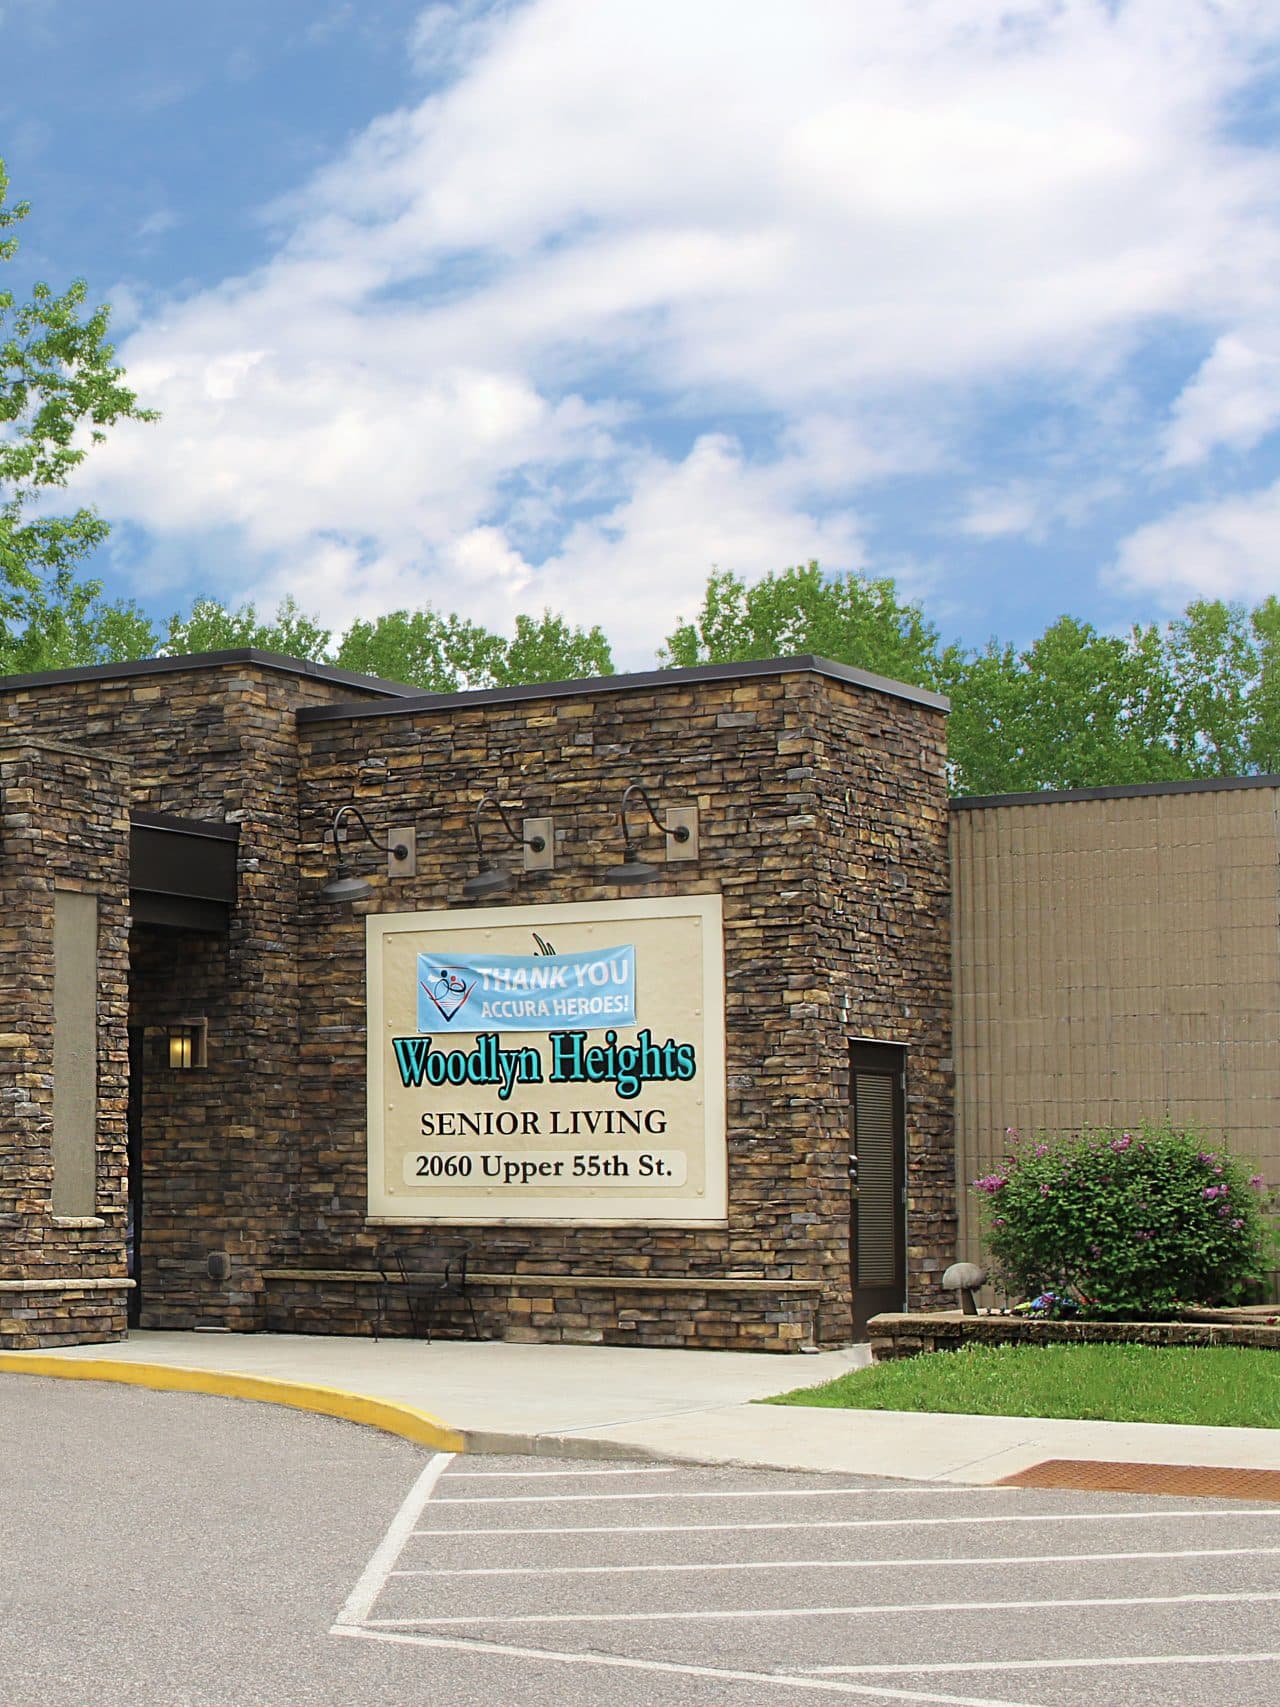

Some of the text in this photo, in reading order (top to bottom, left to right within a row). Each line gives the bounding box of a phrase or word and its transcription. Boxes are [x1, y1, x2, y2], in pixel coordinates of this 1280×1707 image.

[477, 959, 628, 992] THANK YOU
[481, 995, 629, 1018] ACCURA HEROES!
[392, 1029, 696, 1100] Woodlyn Heights
[420, 1109, 668, 1136] SENIOR LIVING
[415, 1154, 672, 1183] 2060 Upper 55th St.
